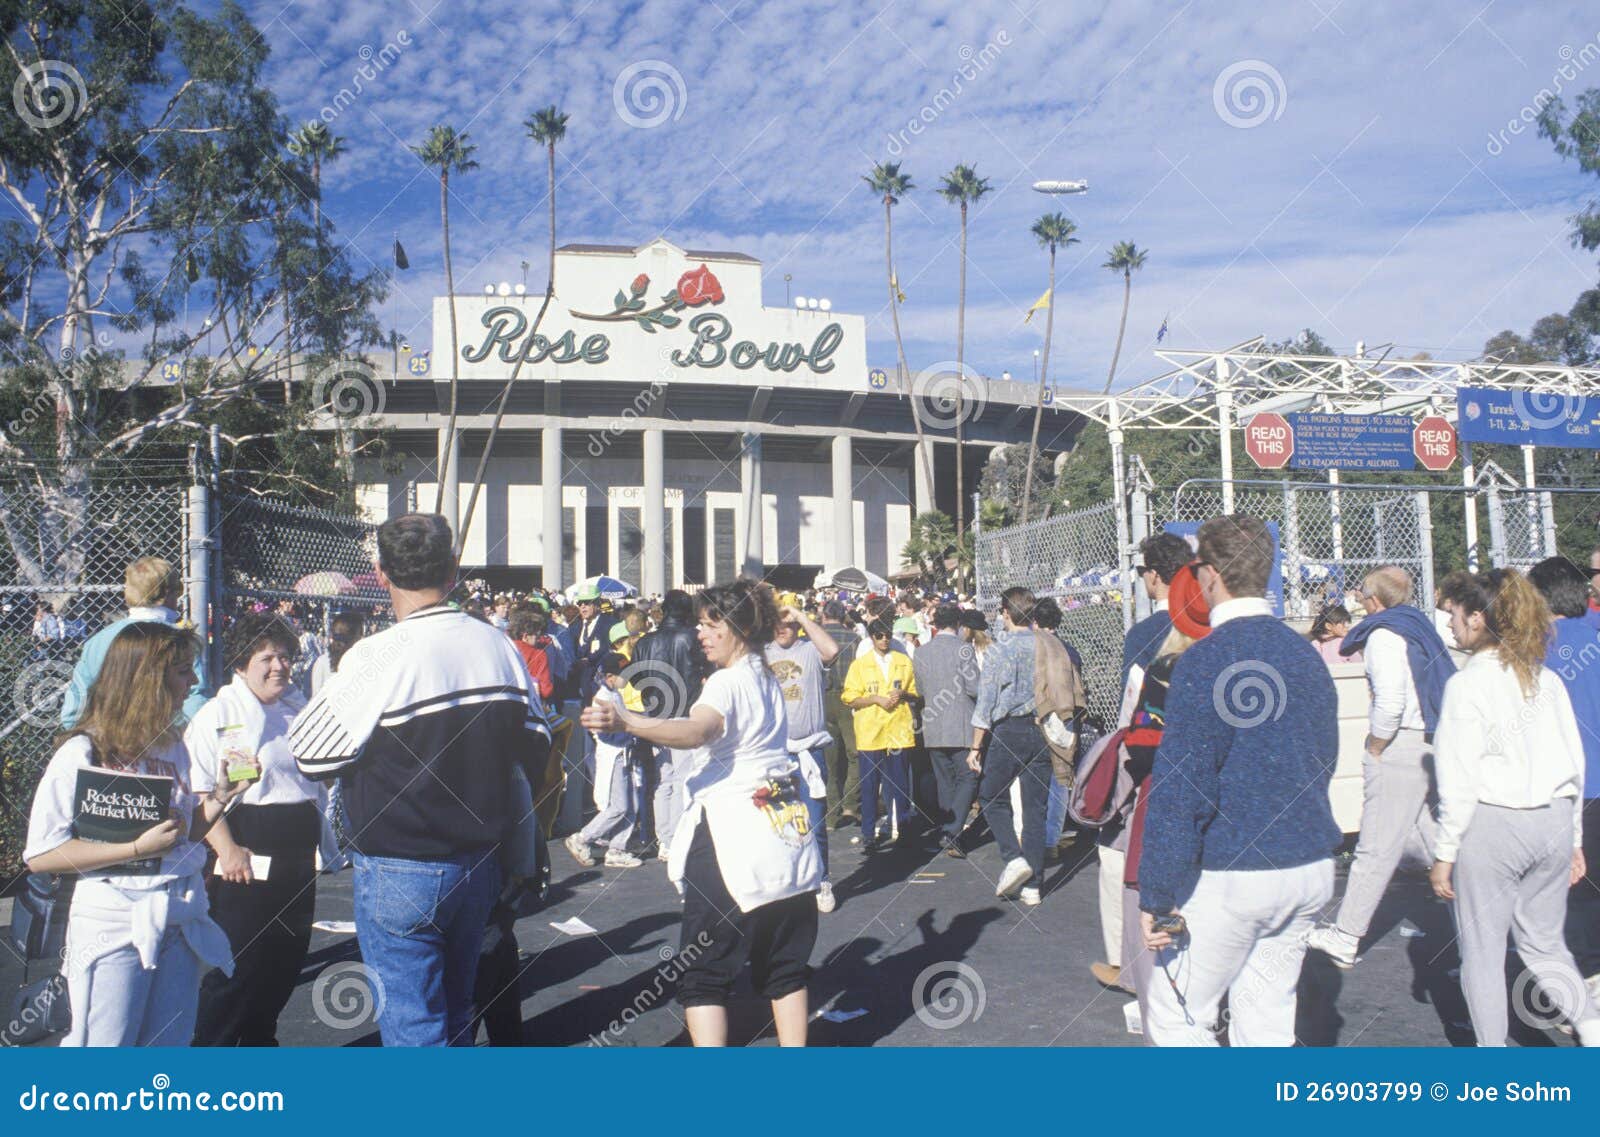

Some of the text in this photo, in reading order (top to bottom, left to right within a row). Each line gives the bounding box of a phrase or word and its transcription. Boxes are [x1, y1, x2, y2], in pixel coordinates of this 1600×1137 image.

[461, 306, 844, 375] Rose Bowl
[164, 364, 179, 378] 24
[411, 358, 427, 371] 25
[871, 373, 885, 385] 26
[1372, 417, 1383, 425] TO
[1251, 427, 1286, 440] READ
[1419, 430, 1451, 443] READ
[1256, 441, 1284, 454] THIS
[1423, 443, 1450, 456] THIS
[1298, 459, 1310, 467] NO
[87, 788, 158, 809] Rock Solid.
[81, 801, 160, 821] Market Wise.
